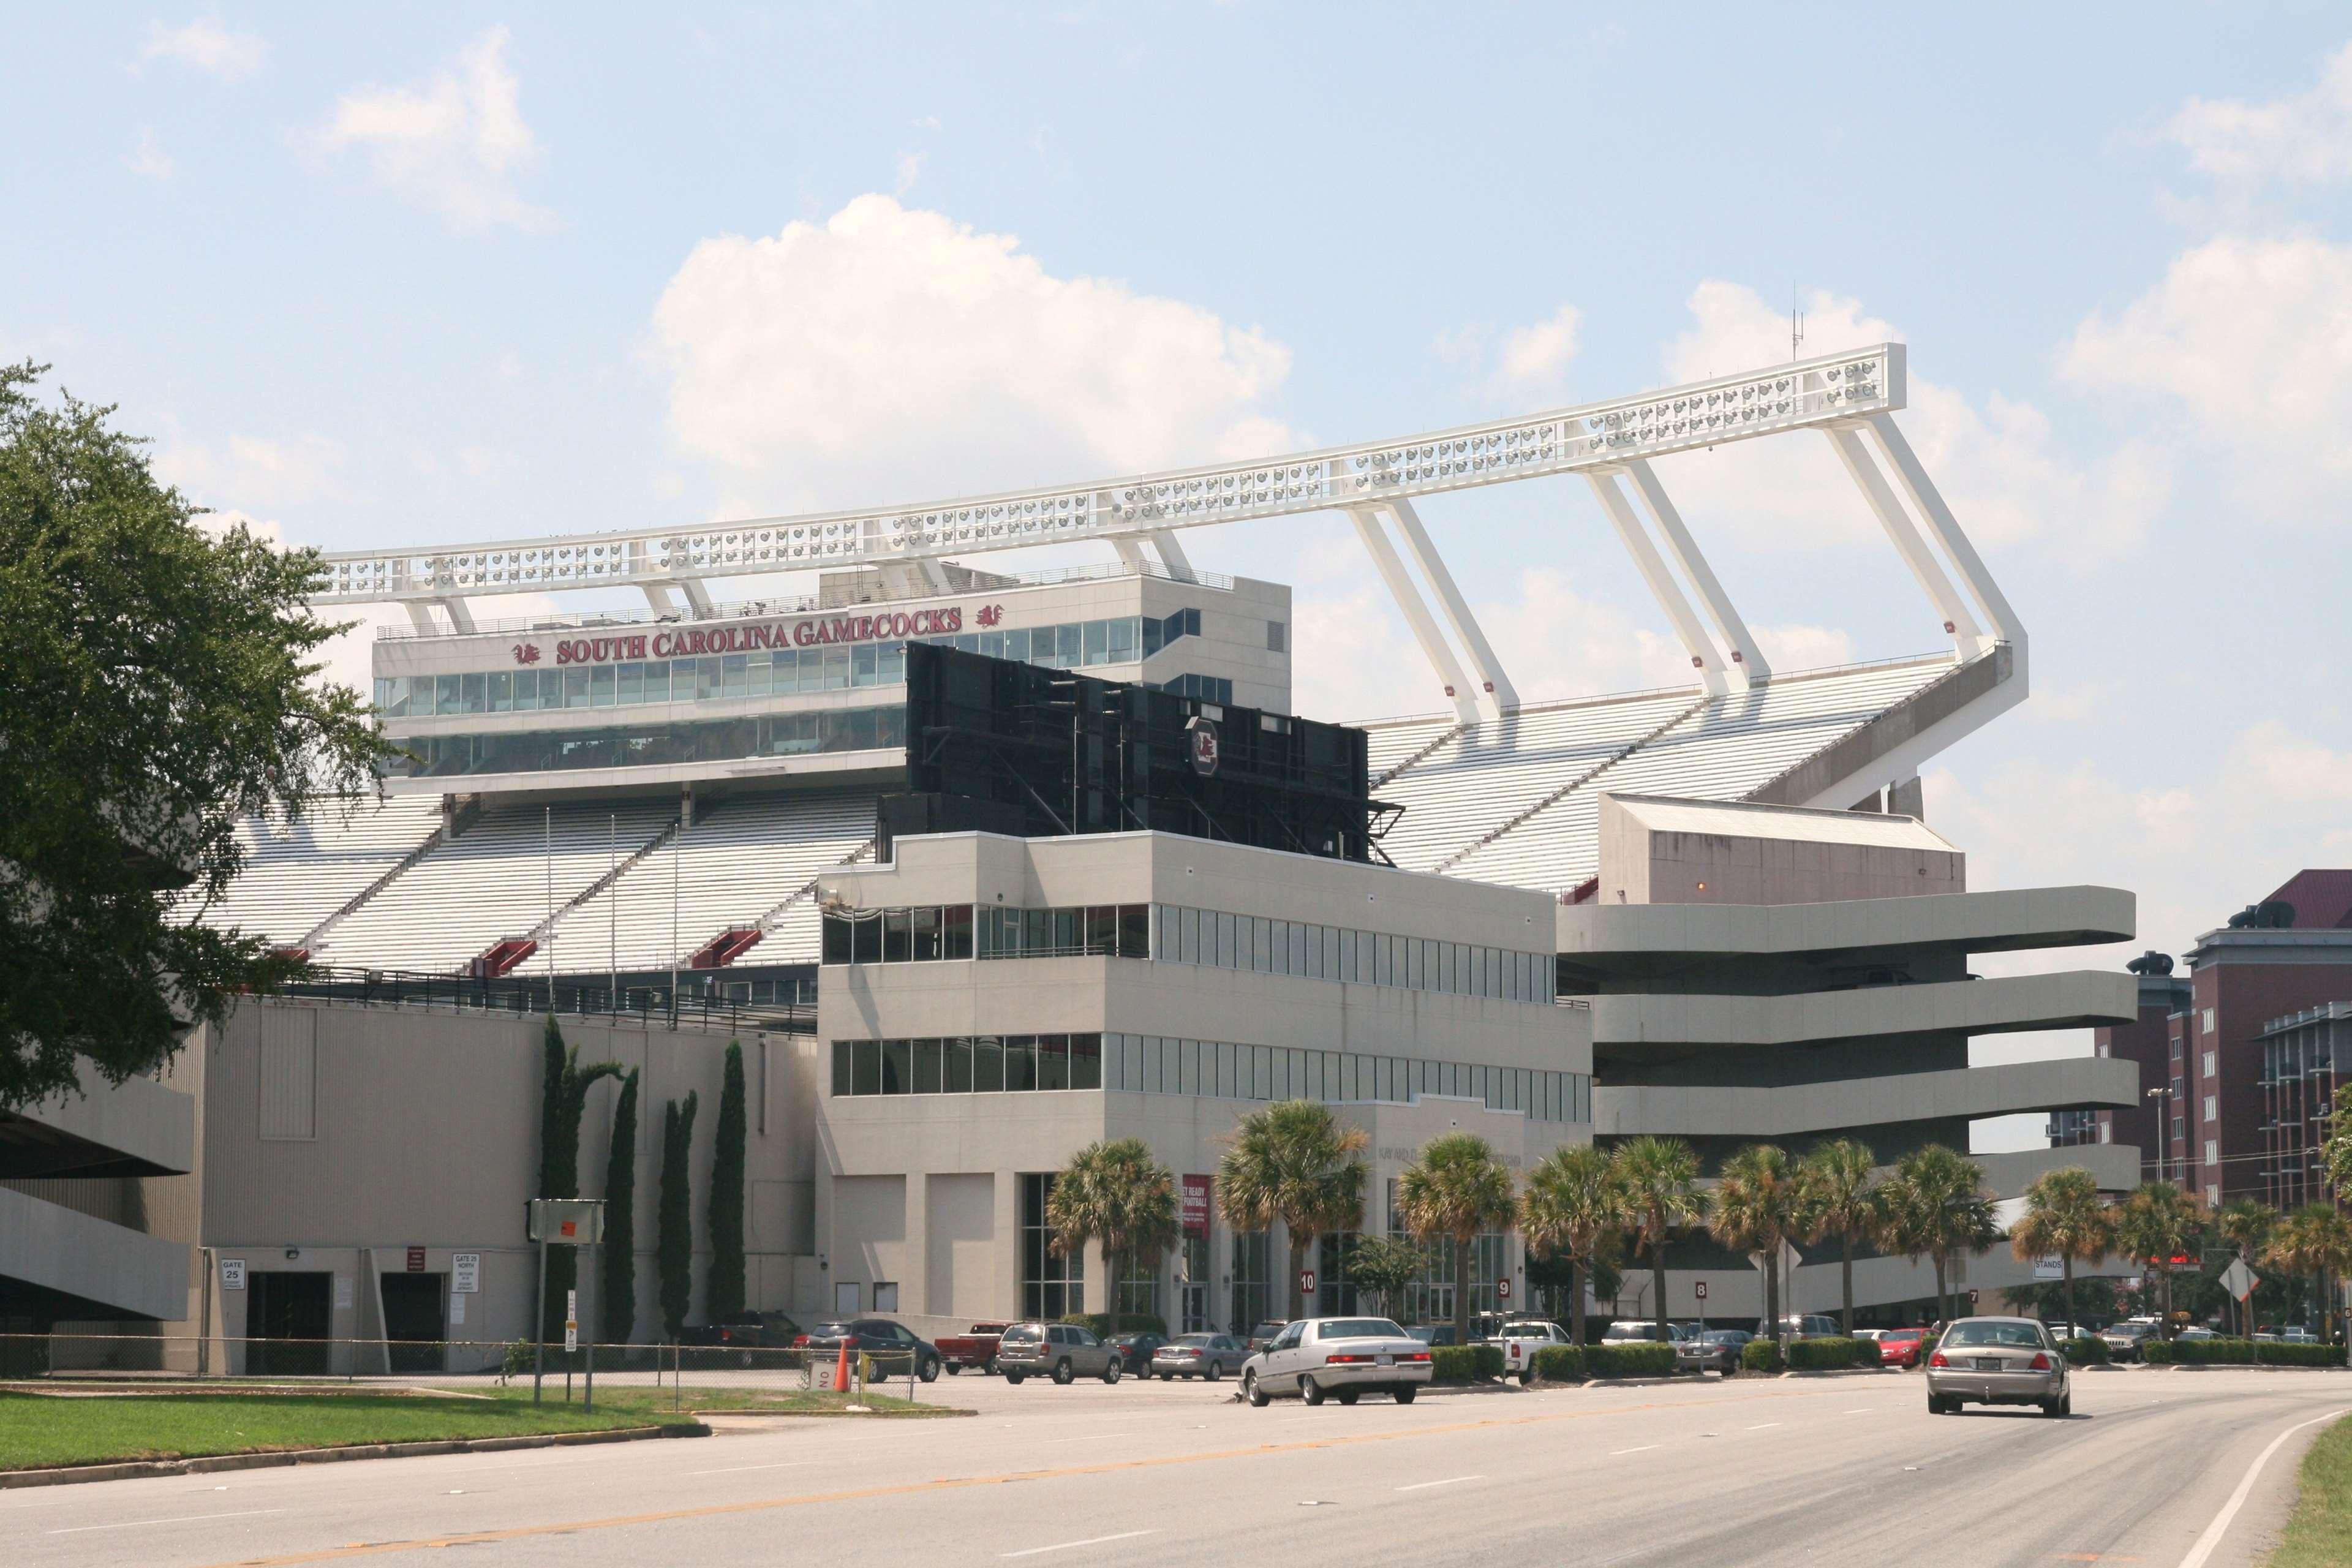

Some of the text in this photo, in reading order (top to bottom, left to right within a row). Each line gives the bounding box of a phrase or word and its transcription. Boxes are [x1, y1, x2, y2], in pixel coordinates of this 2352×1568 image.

[557, 607, 962, 664] SOUTH CAROLINA GAMECOCKS
[1188, 1187, 1205, 1196] READY
[1183, 1197, 1207, 1207] FOOTBALL
[1302, 1275, 1313, 1289] 10
[1499, 1282, 1509, 1294] 9
[1698, 1284, 1705, 1295] 8
[1970, 1292, 1977, 1301] 7
[819, 1371, 829, 1388] NO
